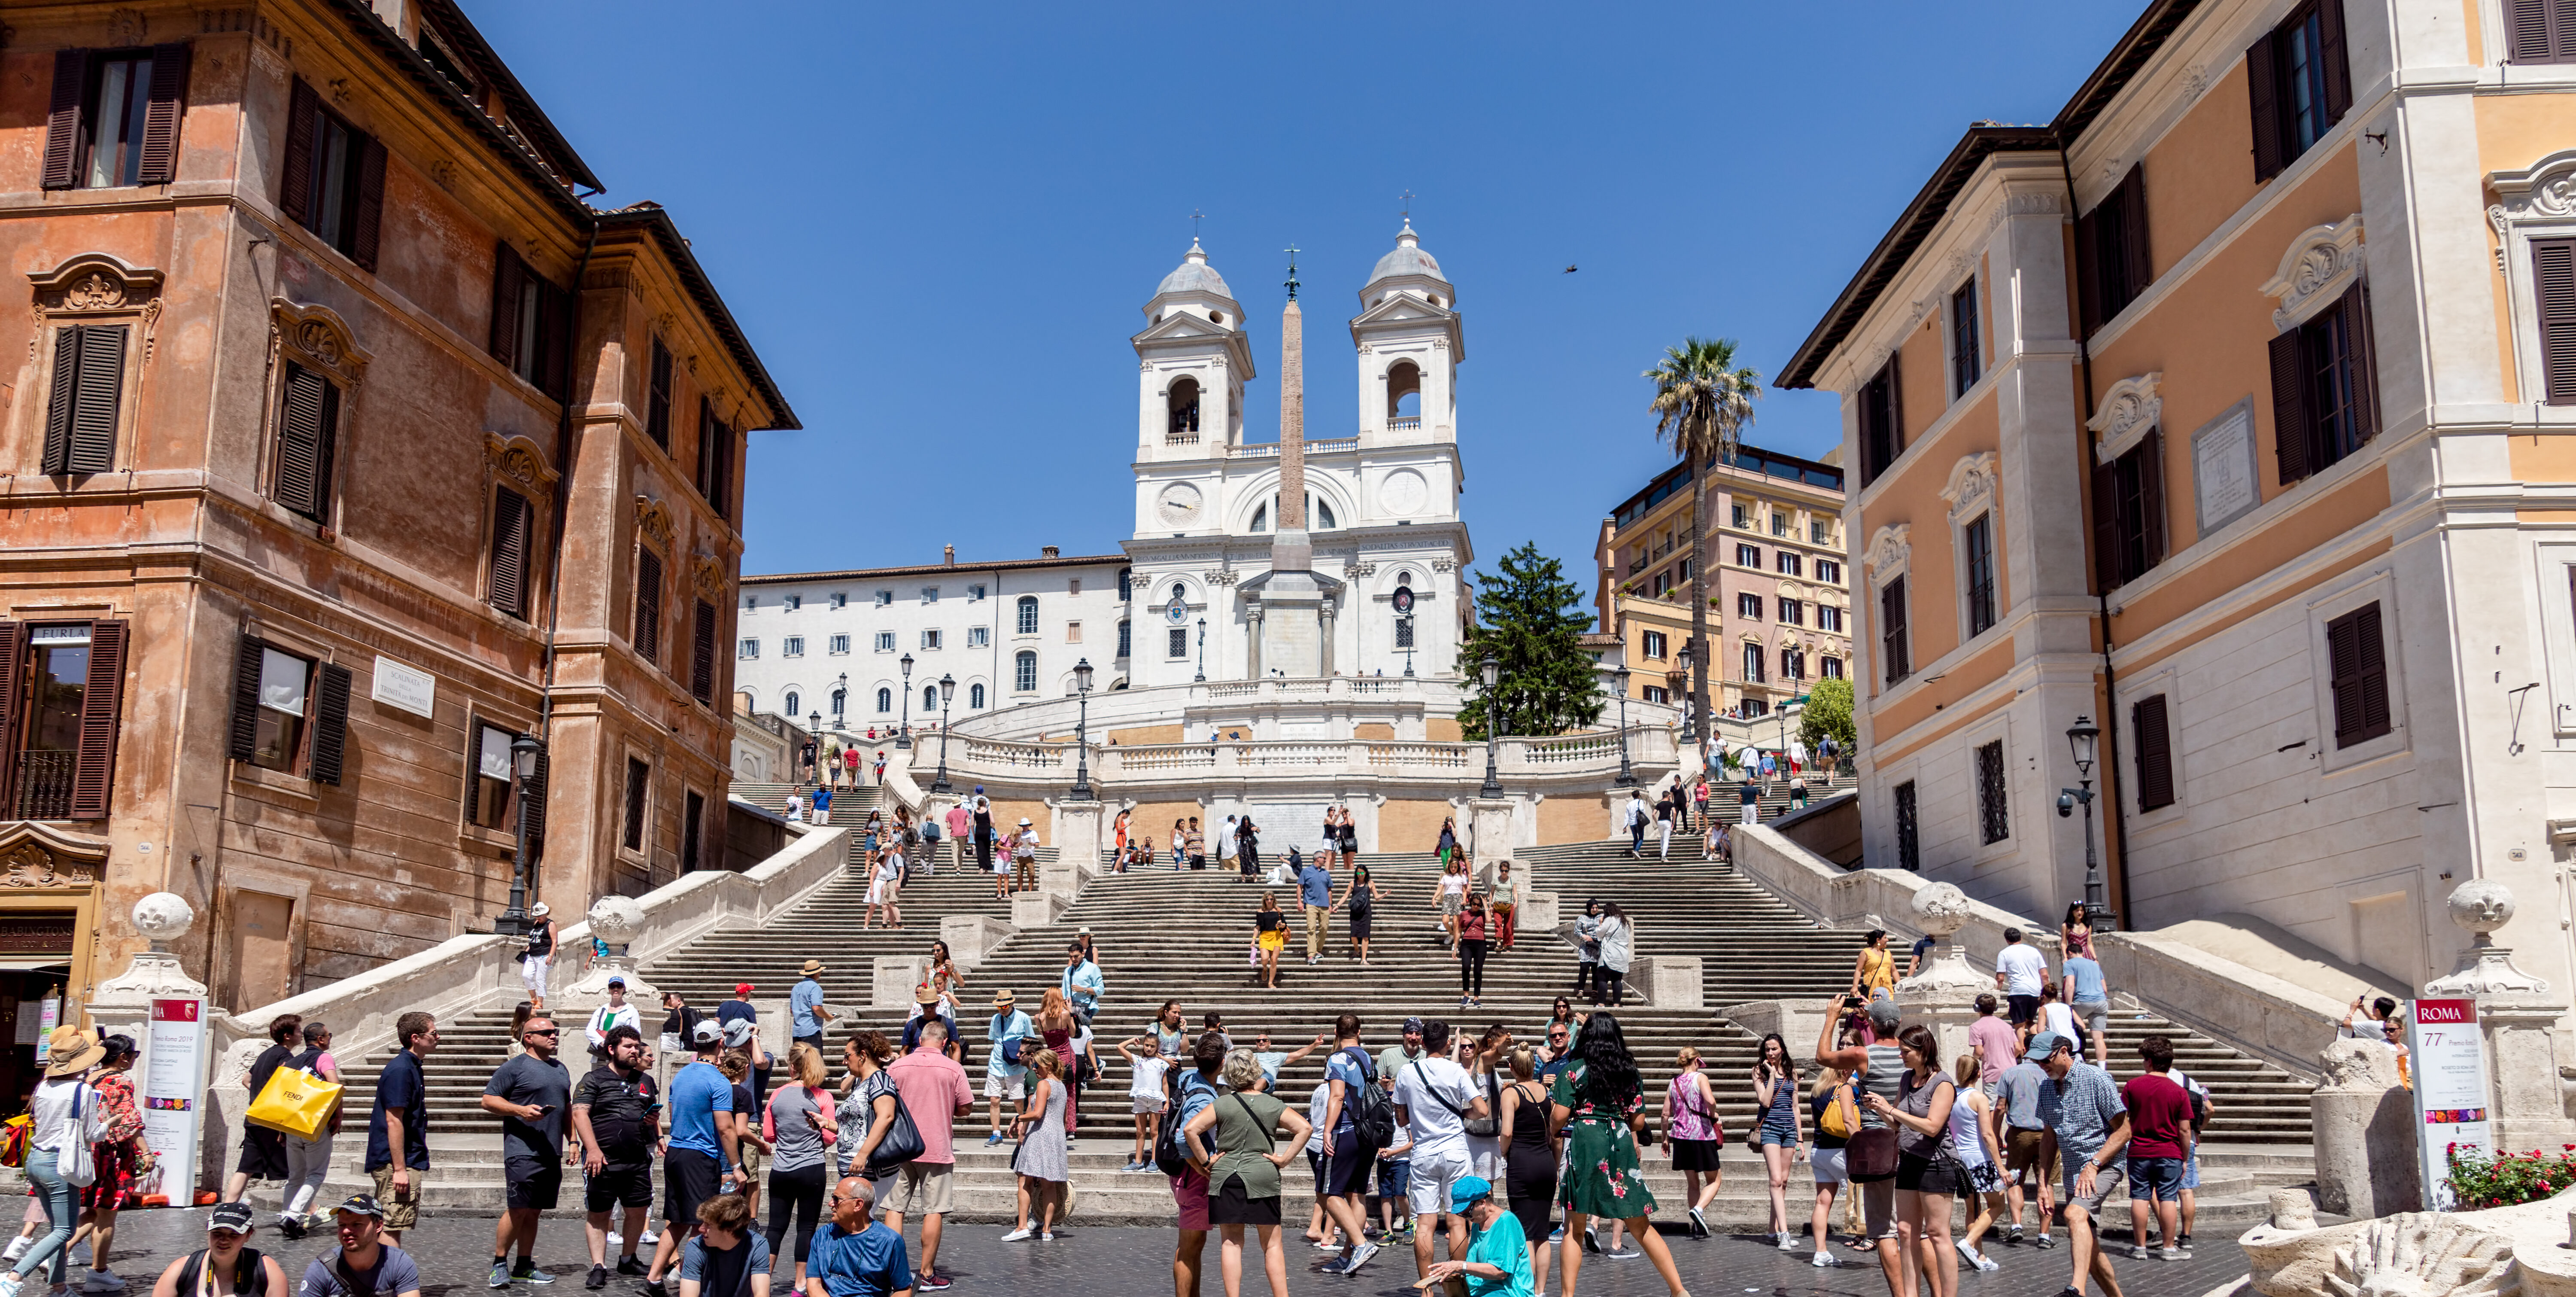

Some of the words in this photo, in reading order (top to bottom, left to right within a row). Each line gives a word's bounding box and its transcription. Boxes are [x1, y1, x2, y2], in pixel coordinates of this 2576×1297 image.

[43, 628, 85, 638] FURLA
[391, 671, 420, 687] SCALINATA
[399, 683, 412, 691] DELLA
[410, 695, 427, 706] MONTI
[1, 926, 73, 937] BABINGTONS
[2421, 1008, 2462, 1020] ROMA
[283, 1091, 304, 1101] FENDI
